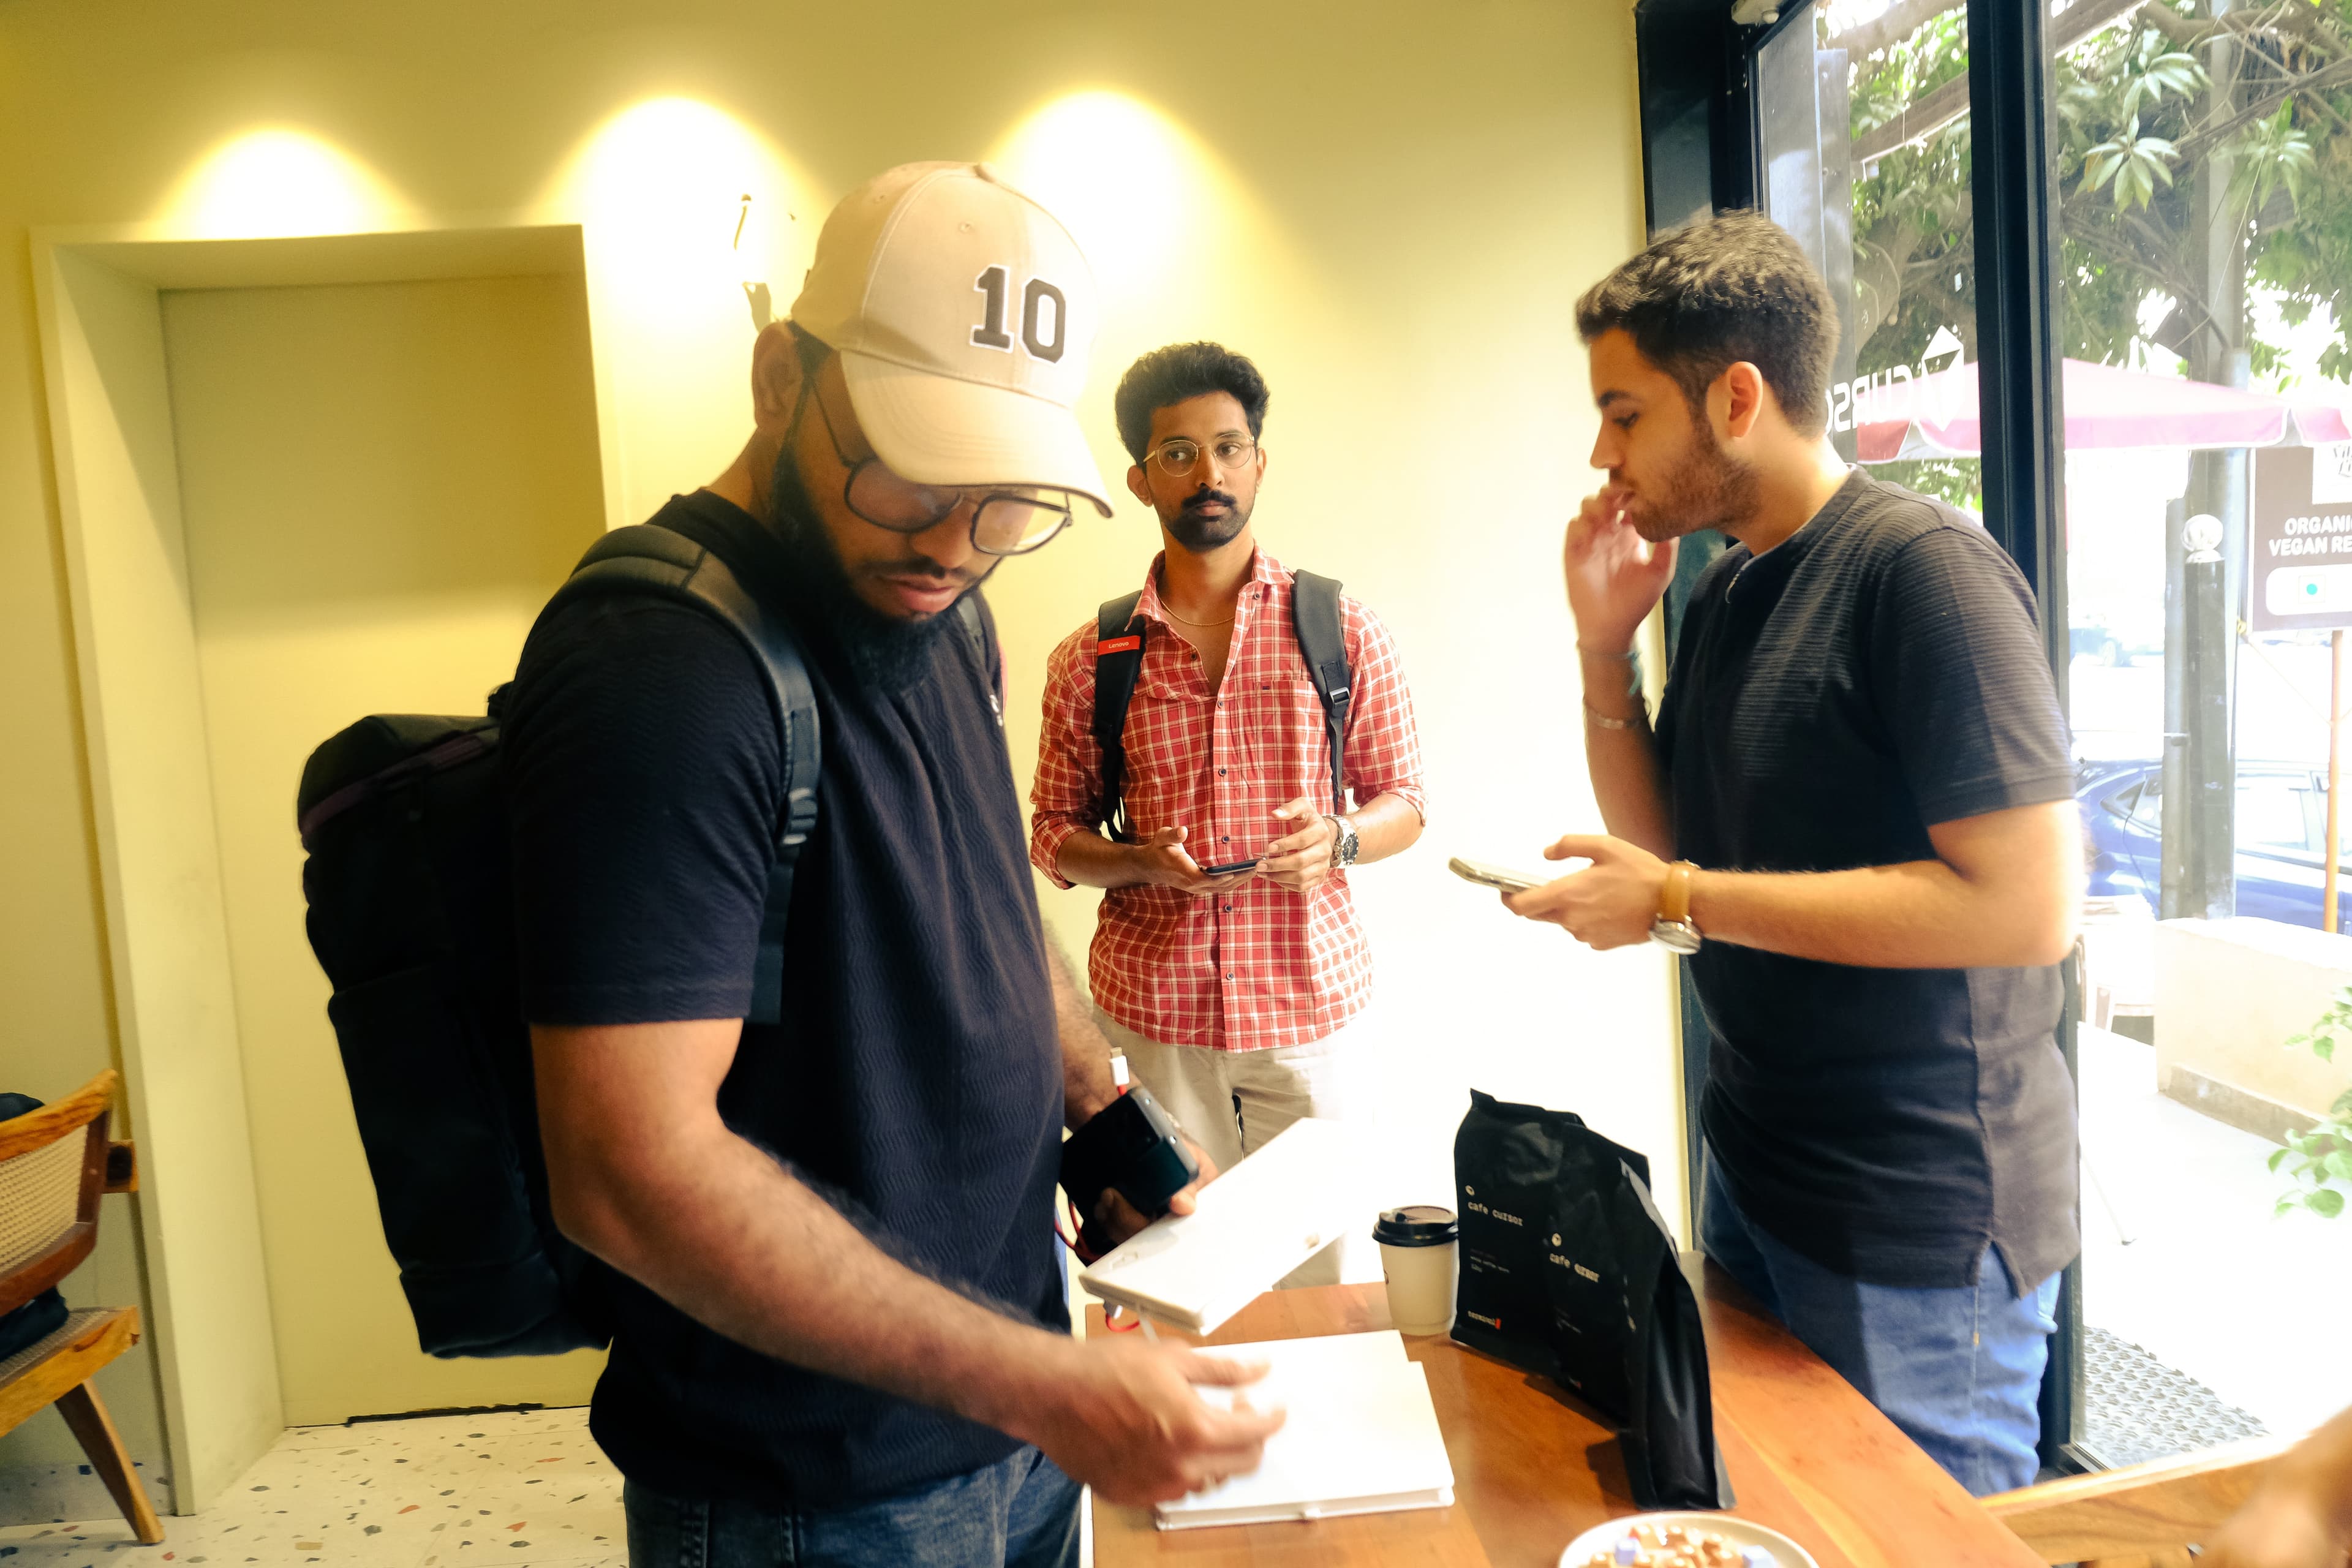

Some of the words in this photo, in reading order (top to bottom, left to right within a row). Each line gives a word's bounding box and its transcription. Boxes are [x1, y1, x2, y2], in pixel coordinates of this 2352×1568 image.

[971, 265, 1066, 364] 10
[2284, 514, 2352, 536] ORGANI
[2268, 537, 2328, 557] VEGAN
[1468, 1201, 1488, 1215] cafe
[1549, 1253, 1571, 1268] cafe
